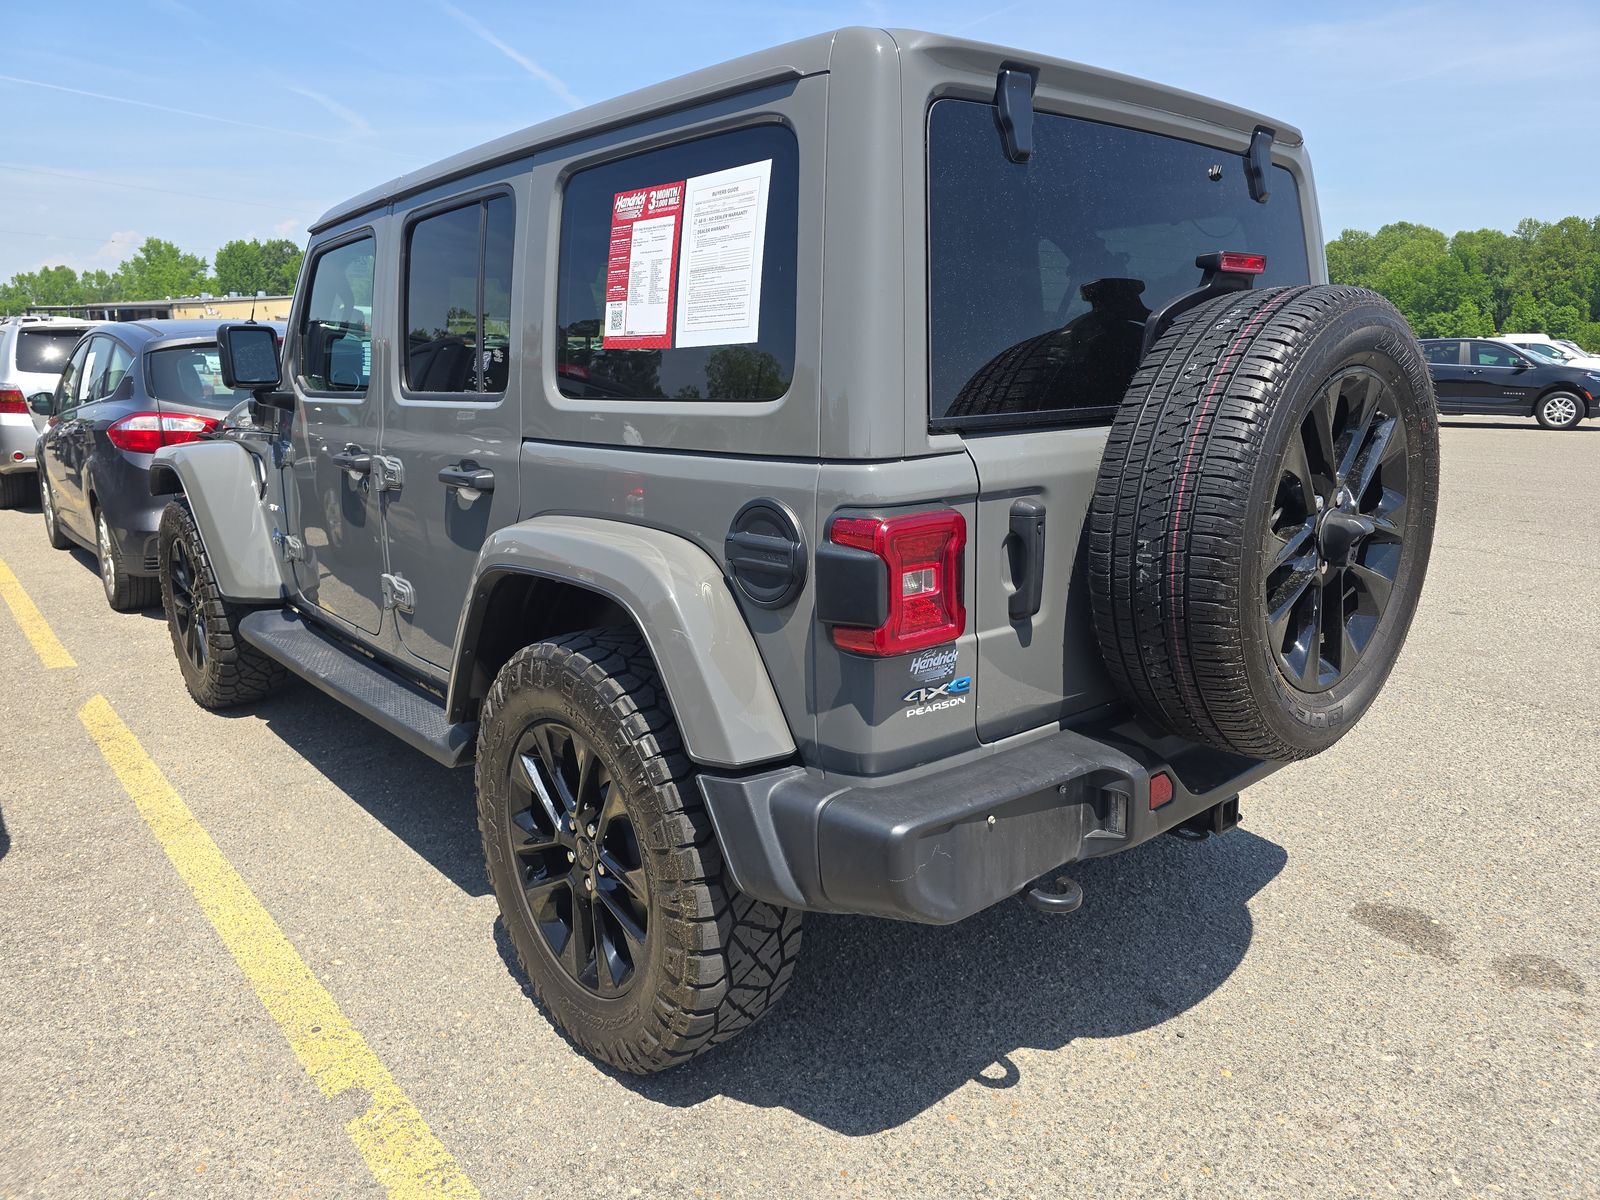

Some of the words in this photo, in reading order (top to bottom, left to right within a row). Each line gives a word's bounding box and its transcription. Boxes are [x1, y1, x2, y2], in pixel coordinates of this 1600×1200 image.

[615, 192, 647, 213] Hendrick
[648, 191, 656, 210] 3
[668, 196, 680, 206] MILE
[712, 189, 727, 197] BUYERS
[910, 649, 958, 675] Hendrick
[906, 696, 966, 718] PEARSON
